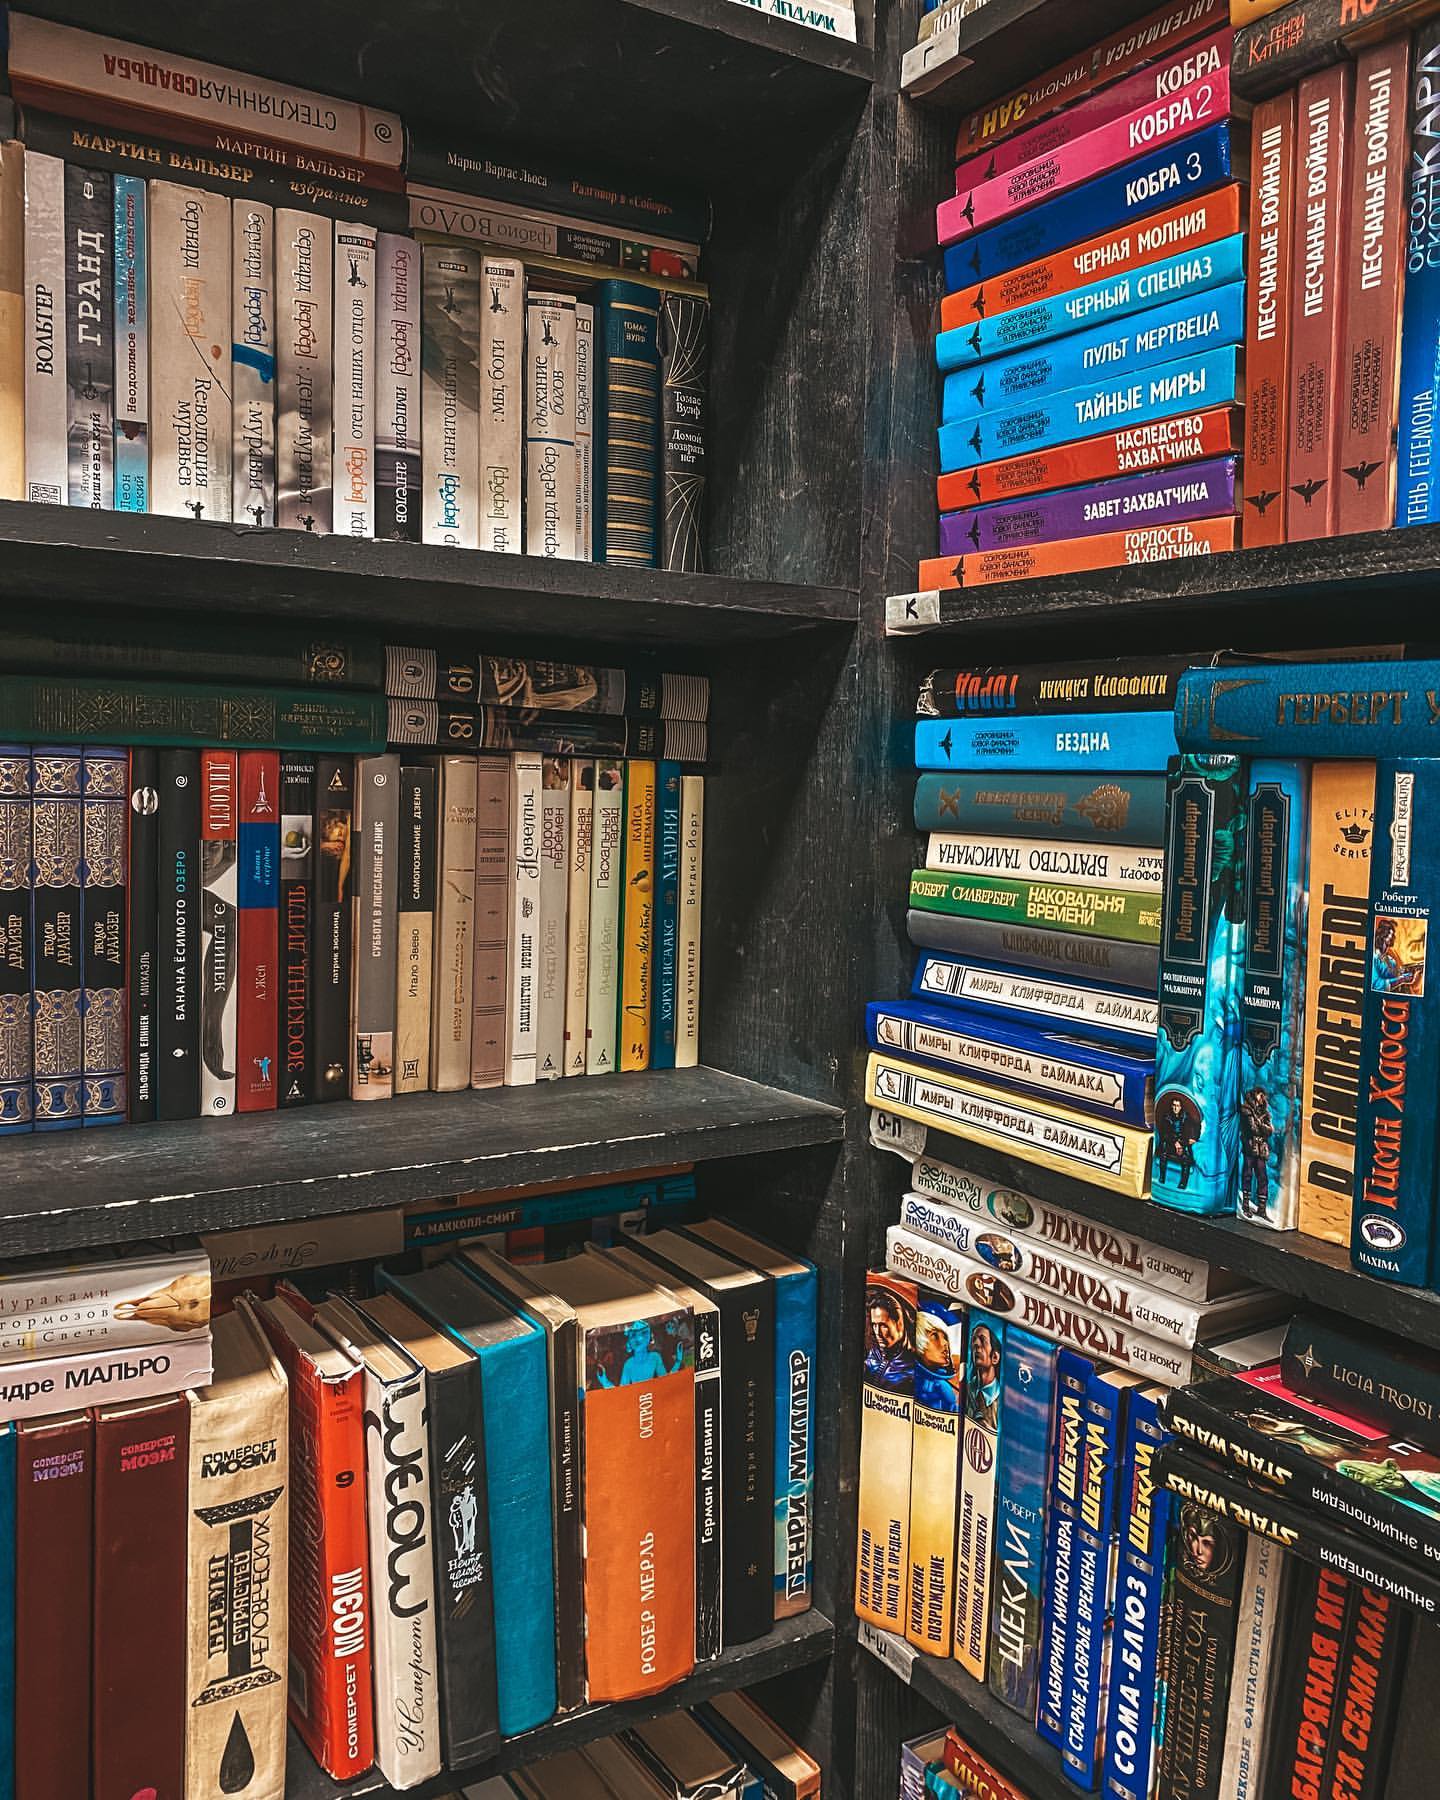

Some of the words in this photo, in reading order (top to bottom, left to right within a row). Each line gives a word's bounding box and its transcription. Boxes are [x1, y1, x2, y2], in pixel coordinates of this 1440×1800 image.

[1270, 14, 1305, 40] ГЕНРИ
[1156, 44, 1221, 99] КОБРА
[1129, 97, 1194, 148] КОБРА
[1196, 85, 1213, 119] 2
[71, 130, 162, 166] МАРТИН
[168, 151, 256, 185] ВАЛЬЗЕР
[215, 134, 289, 167] МАРТИН
[1125, 168, 1181, 206] КОБРА
[1186, 152, 1202, 182] 3
[178, 200, 203, 269] бернард
[243, 213, 266, 280] бернард
[1073, 237, 1131, 275] ЧЕРНАЯ
[1137, 207, 1207, 254] МОЛНИЯ
[1361, 166, 1388, 290] ПЕСЧАНЫЕ
[294, 228, 315, 293] бернард
[1257, 228, 1279, 341] ПЕСЧАНЫЕ
[1304, 198, 1327, 317] ПЕСЧАНЫЕ
[77, 228, 105, 347] ГРАНД
[127, 268, 137, 325] желание
[1065, 280, 1131, 320] ЧЕРНЫЙ
[1137, 256, 1213, 298] СПЕЦНАЗ
[35, 284, 54, 377] ВОЛЬТЕР
[350, 299, 364, 345] отцов
[623, 321, 648, 333] ТОМАС
[1083, 337, 1130, 369] ПУЛЬТ
[1136, 310, 1221, 354] МЕРТВЕЦА
[126, 331, 137, 414] Неодолимое
[350, 348, 364, 405] наших
[490, 338, 506, 387] боги
[395, 386, 408, 450] империя
[552, 370, 565, 417] богов
[1075, 390, 1143, 424] ТАЙНЫЕ
[1150, 367, 1207, 404] МИРЫ
[350, 410, 363, 440] отец
[1115, 416, 1204, 452] НАСЛЕДСТВО
[1409, 389, 1433, 478] ГЕГЕМОНА
[91, 412, 103, 511] Вишневский
[1117, 440, 1204, 470] ЗАХВАТЧИКА
[395, 461, 408, 524] ангелов
[1083, 498, 1120, 522] ЗАВЕТ
[1122, 481, 1209, 515] ЗАХВАТЧИКА
[1408, 487, 1428, 524] ТЕНЬ
[1124, 525, 1194, 551] ГОРДОСТЬ
[905, 598, 919, 618] К
[954, 672, 1020, 712] ГОРОД
[1039, 678, 1089, 702] САЙМАК
[1093, 673, 1168, 698] КЛИФФОРД
[1276, 690, 1409, 725] ГЕРБЕРТ
[1056, 731, 1110, 755] БЕЗДНА
[208, 760, 232, 831] ДИКОСТЬ
[412, 787, 421, 819] ДЗЕНО
[373, 821, 384, 855] ЗИНГЕР
[516, 788, 541, 880] Новеллы
[540, 807, 555, 862] Дорога
[553, 807, 565, 870] перемен
[574, 807, 587, 872] Холодная
[610, 807, 621, 849] парад
[643, 784, 655, 863] ИНГЕМАРСОН
[687, 812, 698, 849] Йорт
[176, 850, 187, 893] ОЗЕРО
[373, 855, 382, 909] ЛИССАБОНЕ
[412, 824, 421, 900] САМОПОЗНАНИЕ
[686, 850, 698, 905] Вигдис
[938, 843, 1021, 870] ТАЛИСМАНА
[1029, 849, 1110, 878] БРАТСТВО
[288, 885, 307, 957] ДИТЛЬ
[910, 879, 950, 899] РОБЕРТ
[951, 885, 1020, 908] СИЛВЕРБЕРГ
[1026, 902, 1097, 927] ВРЕМЕНИ
[1027, 886, 1126, 915] НАКОВАЛЬНЯ
[1374, 901, 1430, 917] Сальваторе
[1382, 890, 1418, 904] Роберт
[173, 899, 187, 968] ЁСИМОТО
[214, 922, 226, 992] ЕЛИНЕК
[332, 911, 340, 950] зюскинд
[372, 917, 382, 957] СУББОТА
[408, 928, 419, 956] Звево
[520, 933, 532, 969] ИРВИНГ
[661, 919, 674, 975] ИСААКС
[141, 951, 150, 996] МИХАЭЛЬ
[332, 955, 340, 985] патрик
[408, 961, 418, 998] Итало
[686, 940, 697, 990] УЧИТЕЛЯ
[1253, 984, 1271, 996] ГОРЫ
[175, 970, 187, 1021] БАНАНА
[520, 974, 532, 1033] ВАШИНГТОН
[661, 978, 673, 1020] ХОРХЕ
[686, 993, 696, 1038] ПЕСНЯ
[969, 976, 1004, 996] МИРЫ
[1009, 984, 1085, 1012] КЛИФФОРДА
[140, 1014, 149, 1047] ЕЛИНЕК
[1368, 998, 1410, 1113] Хаоса
[140, 1050, 149, 1100] ЭЛЬФРИДА
[918, 1032, 952, 1052] МИРЫ
[958, 1045, 1033, 1075] КЛИФФОРДА
[1040, 1065, 1106, 1094] САЙМАКА
[919, 1088, 954, 1110] МИРЫ
[960, 1104, 1035, 1137] КЛИФФОРДА
[1042, 1126, 1107, 1160] САЙМАКА
[1363, 1116, 1402, 1211] Гимн
[1028, 1249, 1135, 1322] ТОЛКИН
[1359, 1250, 1401, 1273] MAXIMA
[1022, 1292, 1131, 1365] ТОЛКИН
[64, 1355, 171, 1390] МАЛЬРО
[1331, 1364, 1374, 1394] LICIA
[1378, 1383, 1433, 1421] TROISI
[562, 1410, 572, 1466] Мелвилл
[638, 1392, 654, 1440] ОСТРОВ
[700, 1407, 714, 1478] Мелвилл
[787, 1349, 811, 1483] МИЛЛЕР
[1170, 1414, 1229, 1460] WARS
[33, 1450, 85, 1469] СОМЕРСЕТ
[33, 1462, 85, 1482] МОЭМ
[120, 1435, 176, 1456] СОМЕРСЕТ
[120, 1447, 176, 1472] МОЭМ
[201, 1450, 277, 1479] МОЭМ
[202, 1438, 278, 1463] СОМЕРСЕТ
[1056, 1395, 1084, 1501] ШЕКЛИ
[1231, 1444, 1293, 1486] STAR
[562, 1468, 574, 1513] Герман
[1079, 1422, 1110, 1532] ШЕКЛИ
[1166, 1472, 1228, 1517] WARS
[701, 1482, 714, 1544] Герман
[889, 1519, 902, 1558] ПРЕДЕЛЫ
[1230, 1502, 1299, 1547] STAR
[1311, 1486, 1418, 1554] ЭНЦИКЛОПЕДИЯ
[639, 1531, 656, 1604] МЕРЛЬ
[786, 1494, 808, 1601] ГЕНРИ
[862, 1528, 872, 1565] ПРИЛИВ
[955, 1570, 970, 1649] АСТРОНАВТЫ
[963, 1490, 975, 1558] ЛОХМОТЬЯХ
[974, 1513, 988, 1581] КОСМОЛЕТЫ
[1054, 1520, 1074, 1625] МИНОТАВРА
[207, 1553, 229, 1660] БРЕМЯ
[860, 1567, 871, 1608] ЛЕТНИЙ
[871, 1543, 885, 1615] РАСХОЖДЕНИЕ
[886, 1582, 899, 1619] ВЫХОД
[910, 1563, 925, 1636] СХОЖДЕНИЕ
[927, 1554, 946, 1643] ВОЗРОЖДЕНИЕ
[998, 1519, 1032, 1669] ШЕКЛИ
[1077, 1549, 1098, 1623] ВРЕМЕНА
[1319, 1547, 1436, 1613] ЭНЦИКЛОПЕДИЯ
[331, 1566, 365, 1659] МОЭМ
[969, 1582, 985, 1662] ДЕРЕВЯННЫЕ
[640, 1610, 657, 1675] РОБЕР
[1047, 1622, 1067, 1718] ЛАБИРИНТ
[1075, 1621, 1092, 1694] ДОБРЫЕ
[345, 1662, 360, 1760] СОМЕРСЕТ
[1069, 1689, 1087, 1752] СТАРЫЕ
[1195, 1722, 1211, 1789] ФЭНТЕЗИ
